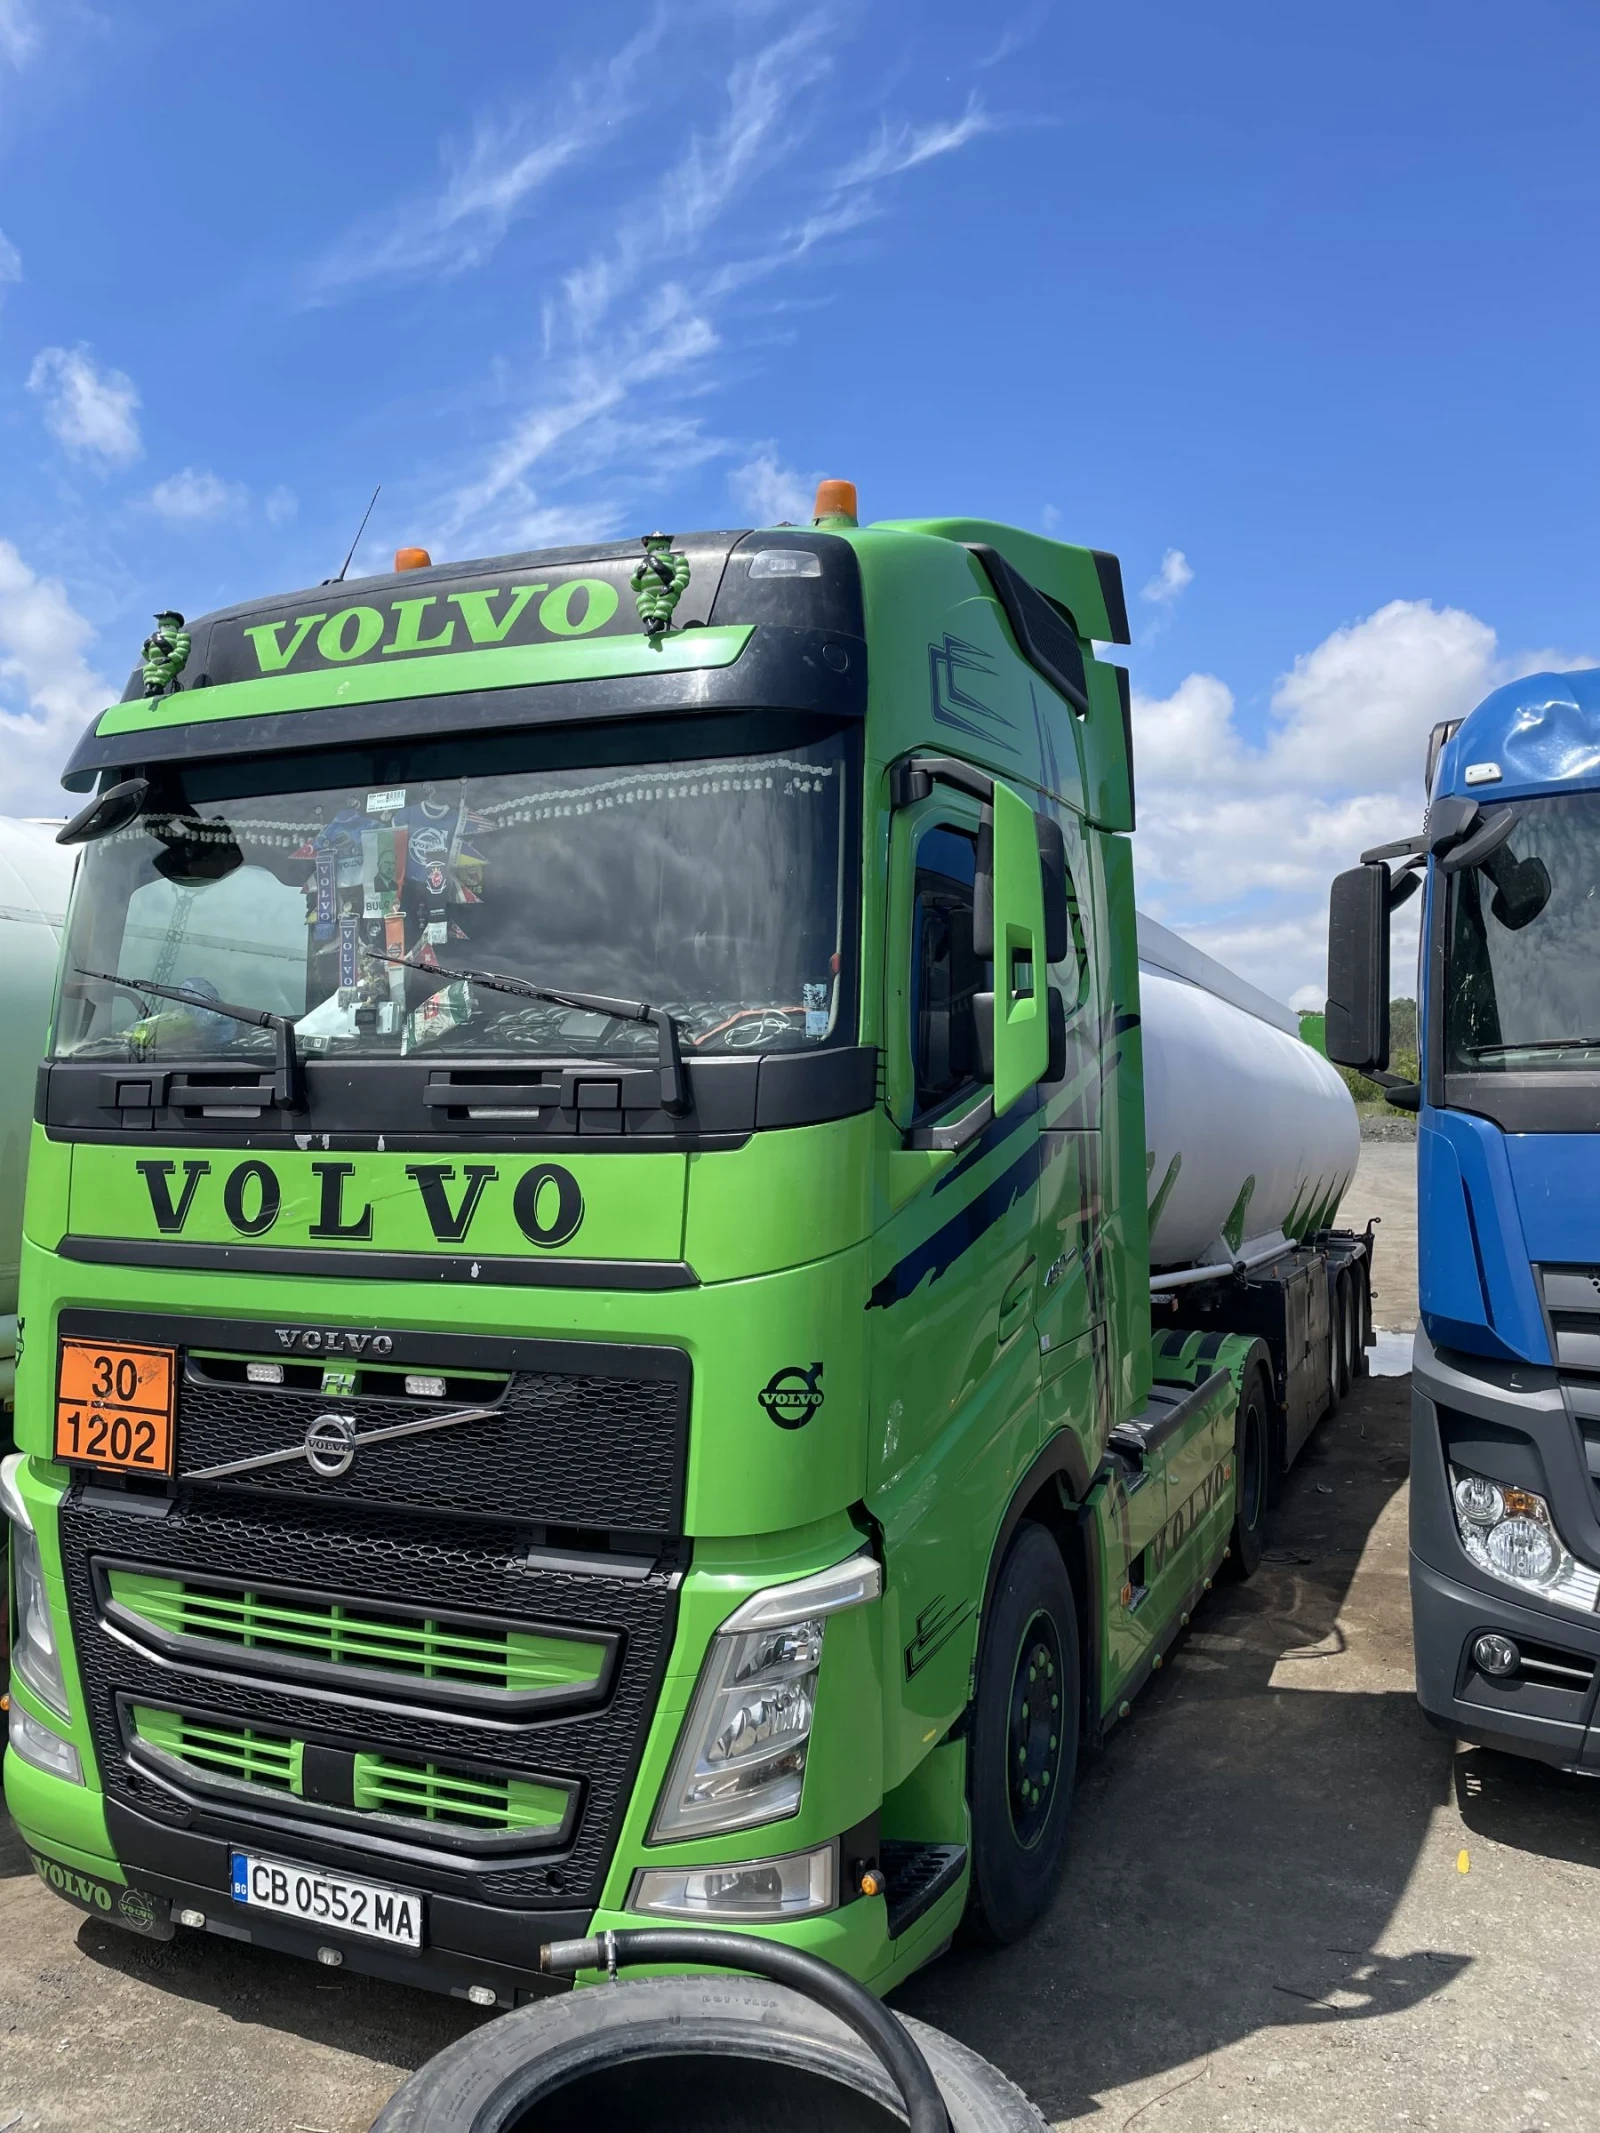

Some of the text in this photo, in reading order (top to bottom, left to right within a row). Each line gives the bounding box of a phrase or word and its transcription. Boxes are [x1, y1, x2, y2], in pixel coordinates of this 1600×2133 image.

[244, 578, 619, 672] VOLVO
[320, 866, 330, 921] VOLVO
[366, 900, 390, 911] BULG
[343, 931, 353, 986] VOLVO
[136, 1160, 585, 1249] VOLVO
[275, 1329, 393, 1354] VOLVO
[92, 1356, 137, 1401] 30
[321, 1373, 356, 1391] FH
[761, 1393, 823, 1404] VOLVO
[67, 1411, 156, 1464] 1202
[308, 1439, 350, 1453] VOLVO
[1151, 1462, 1224, 1573] VOLVO
[31, 1854, 112, 1911] VOLVO
[235, 1882, 247, 1894] BG
[252, 1866, 413, 1939] CB 0552 MA
[121, 1903, 154, 1921] VOLVO
